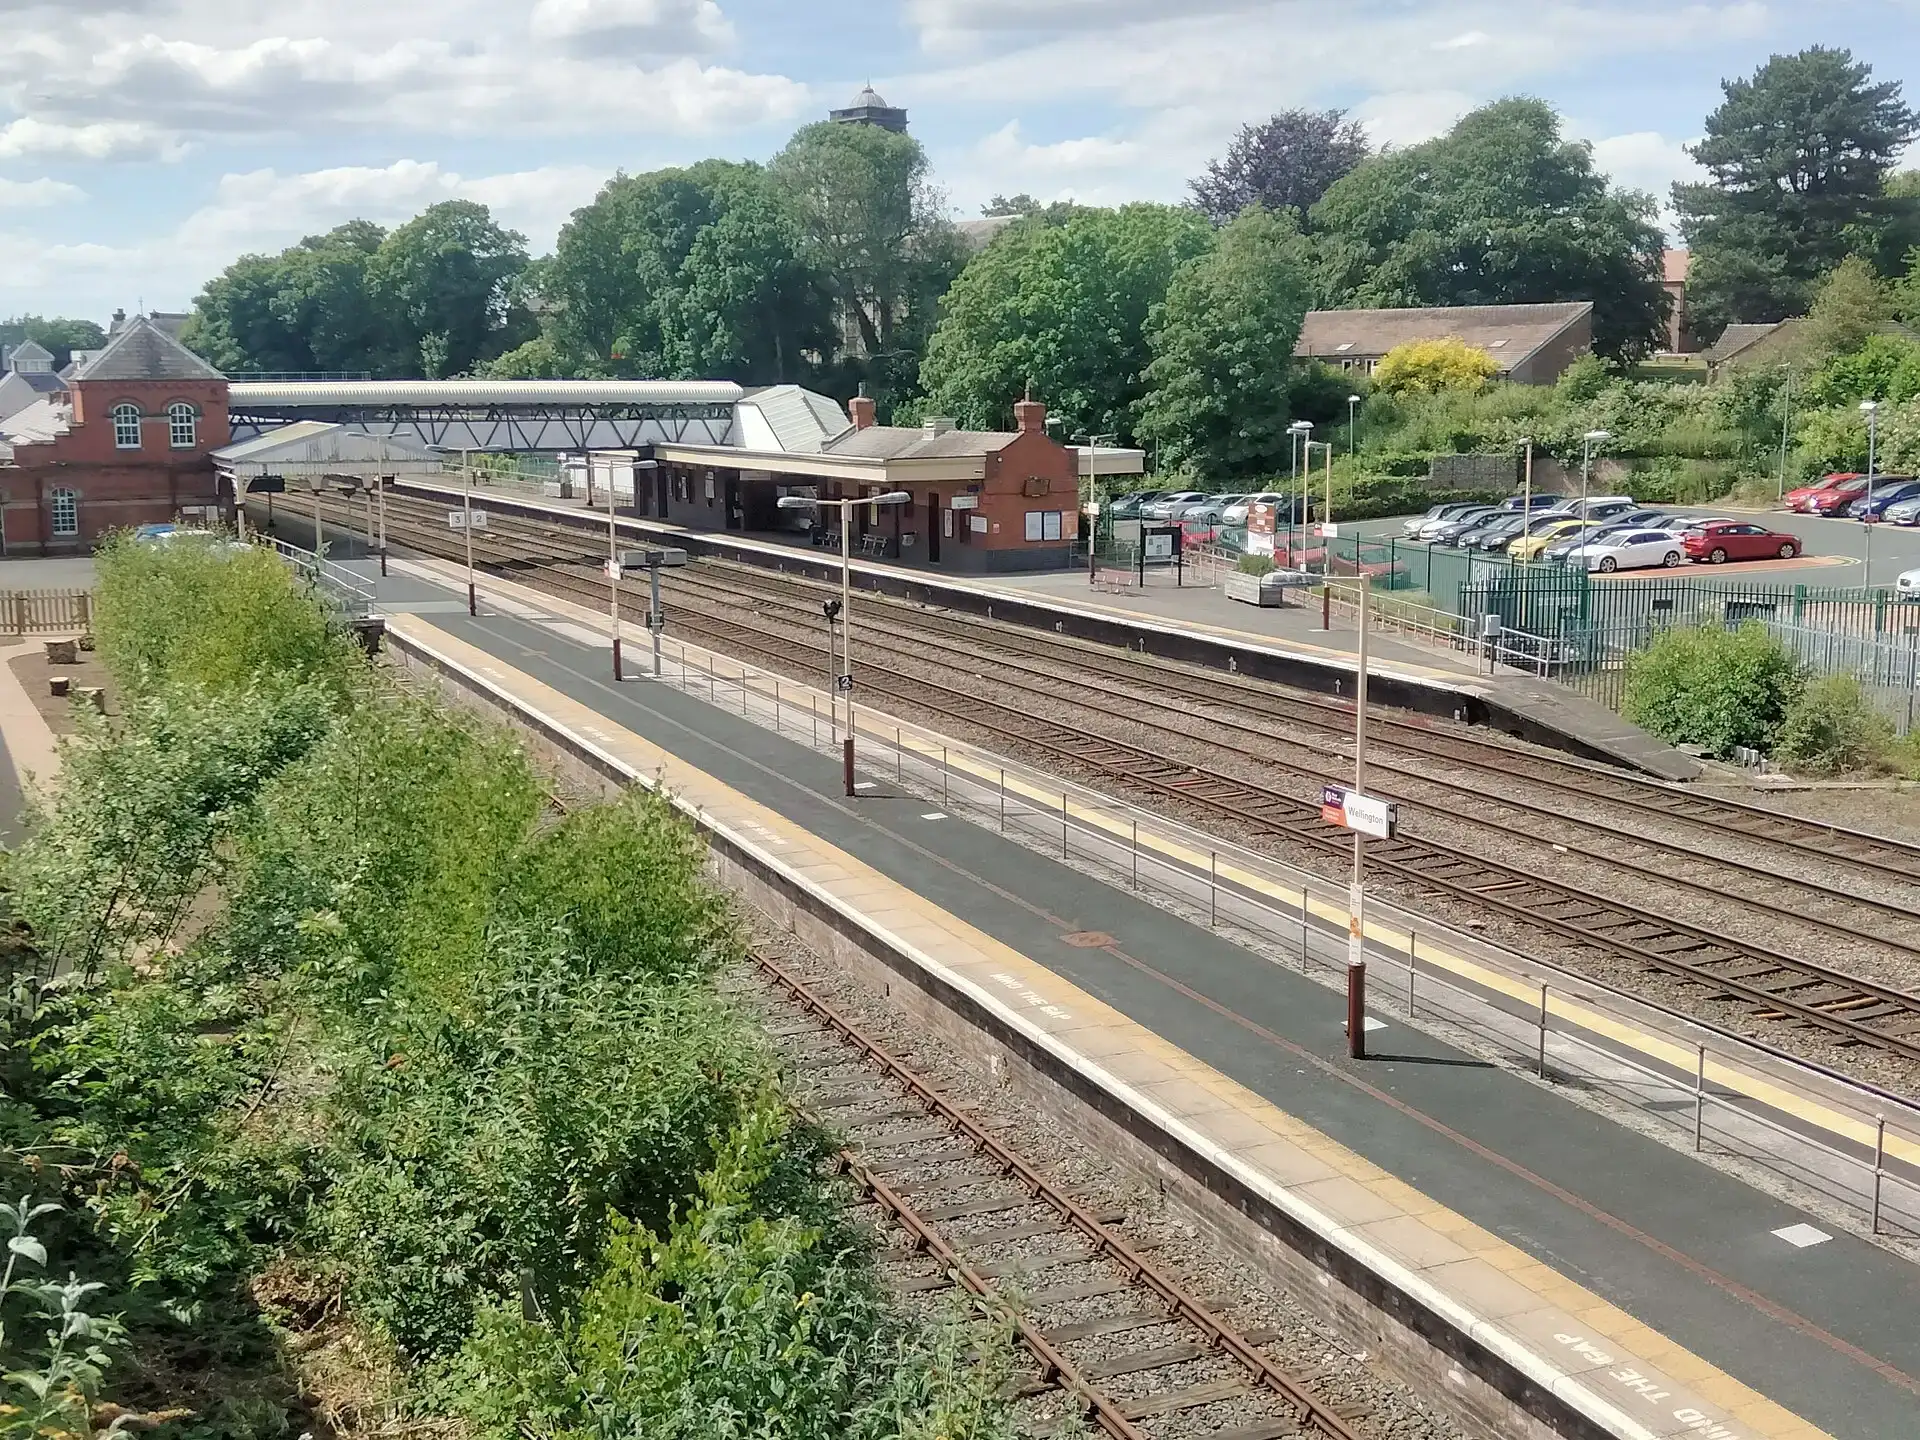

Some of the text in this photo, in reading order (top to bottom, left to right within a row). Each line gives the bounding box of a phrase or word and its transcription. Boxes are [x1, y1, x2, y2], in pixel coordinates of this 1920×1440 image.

[455, 515, 461, 523] 3
[476, 514, 483, 523] 2
[842, 677, 849, 687] 2
[1348, 806, 1384, 825] Wellington
[1019, 990, 1049, 1006] THE
[1553, 1333, 1741, 1440] IND THE GAP
